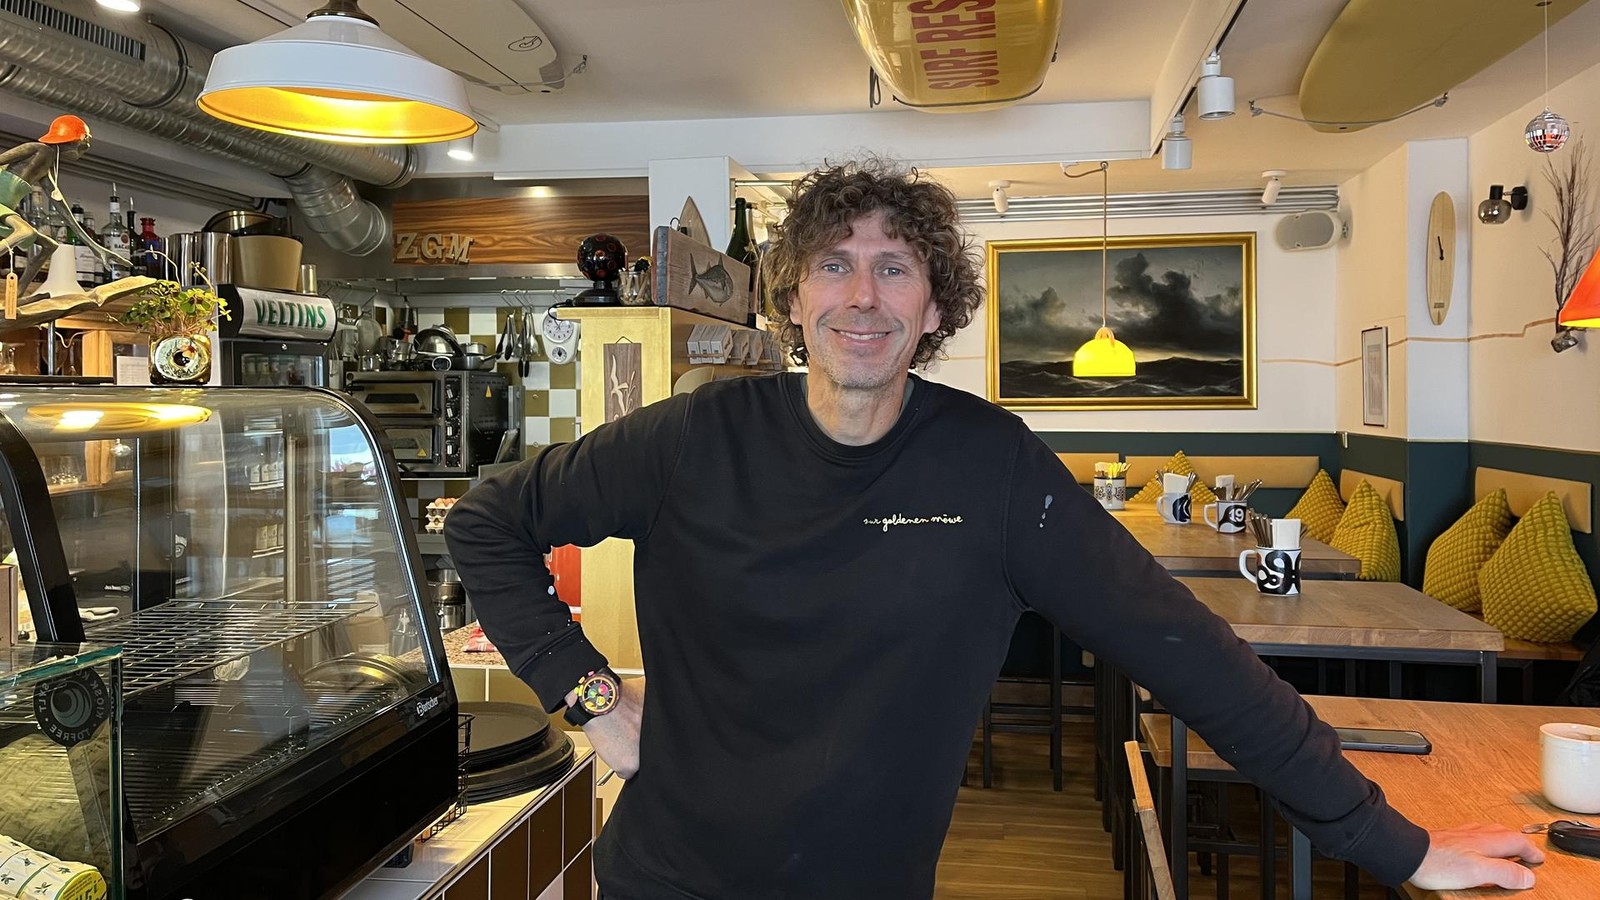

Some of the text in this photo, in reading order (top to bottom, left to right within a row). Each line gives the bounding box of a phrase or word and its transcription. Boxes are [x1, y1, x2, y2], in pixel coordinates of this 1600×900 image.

[920, 48, 1000, 90] SURF
[396, 232, 473, 263] ZGM
[253, 299, 327, 329] VELTINS
[882, 513, 929, 532] goldenen
[1228, 508, 1244, 523] 19
